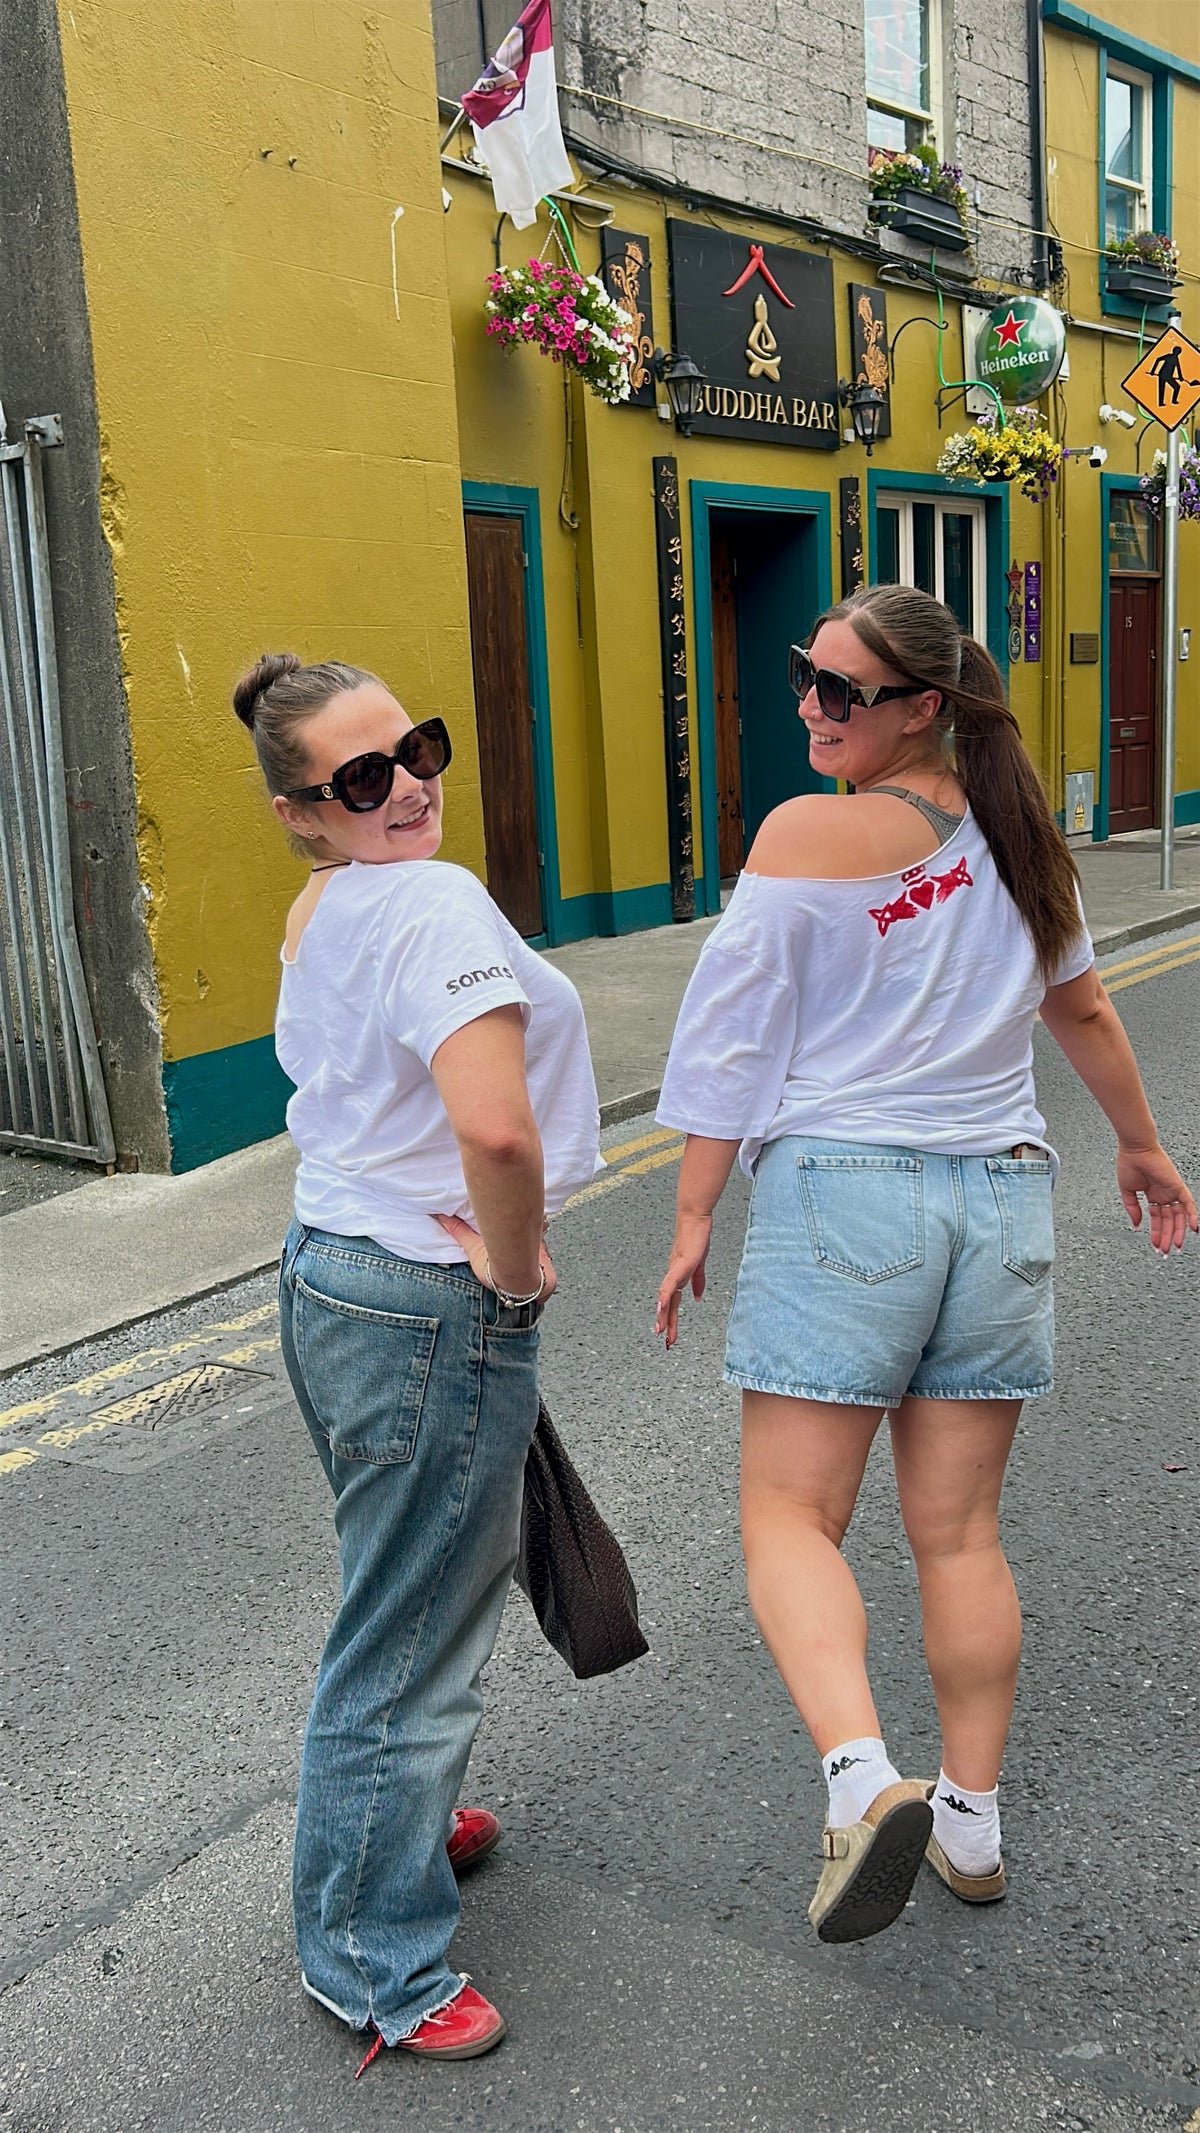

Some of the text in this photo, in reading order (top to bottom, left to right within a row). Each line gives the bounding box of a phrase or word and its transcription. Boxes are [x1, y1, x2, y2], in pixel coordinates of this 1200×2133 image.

[981, 351, 1050, 376] Heineken
[791, 398, 839, 432] BAR
[1125, 616, 1133, 628] 15
[446, 966, 514, 995] sonas
